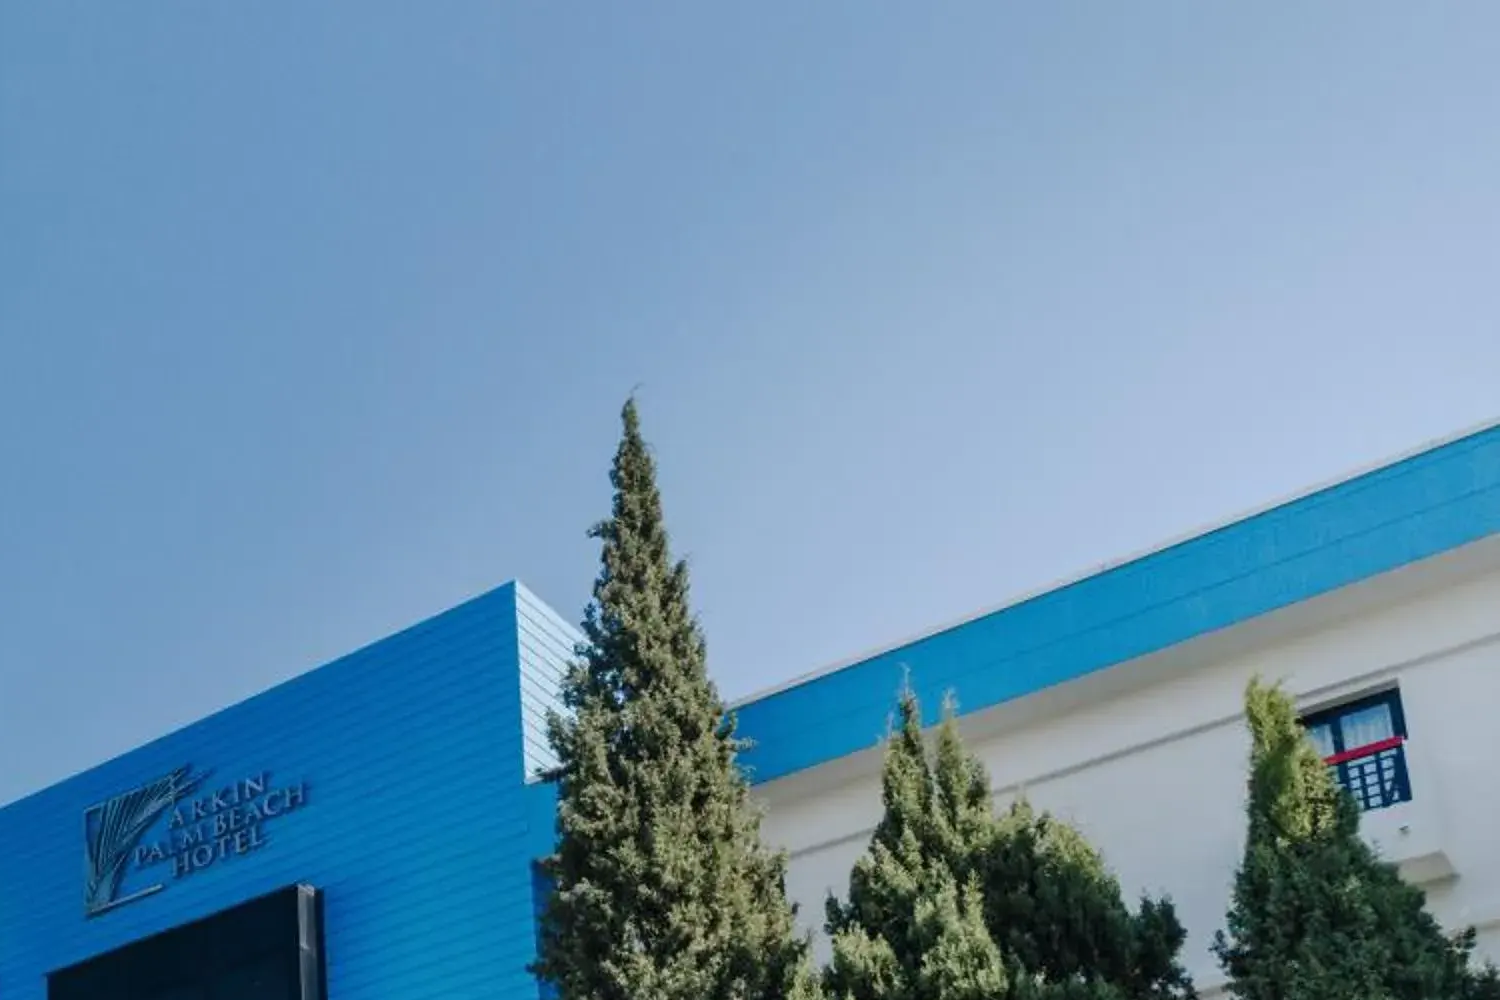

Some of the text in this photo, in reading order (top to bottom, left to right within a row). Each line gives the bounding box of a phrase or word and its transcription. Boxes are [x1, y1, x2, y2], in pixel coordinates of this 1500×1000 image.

[169, 772, 265, 829] ARKIN
[213, 782, 306, 836] BEACH
[169, 825, 263, 878] HOTEL
